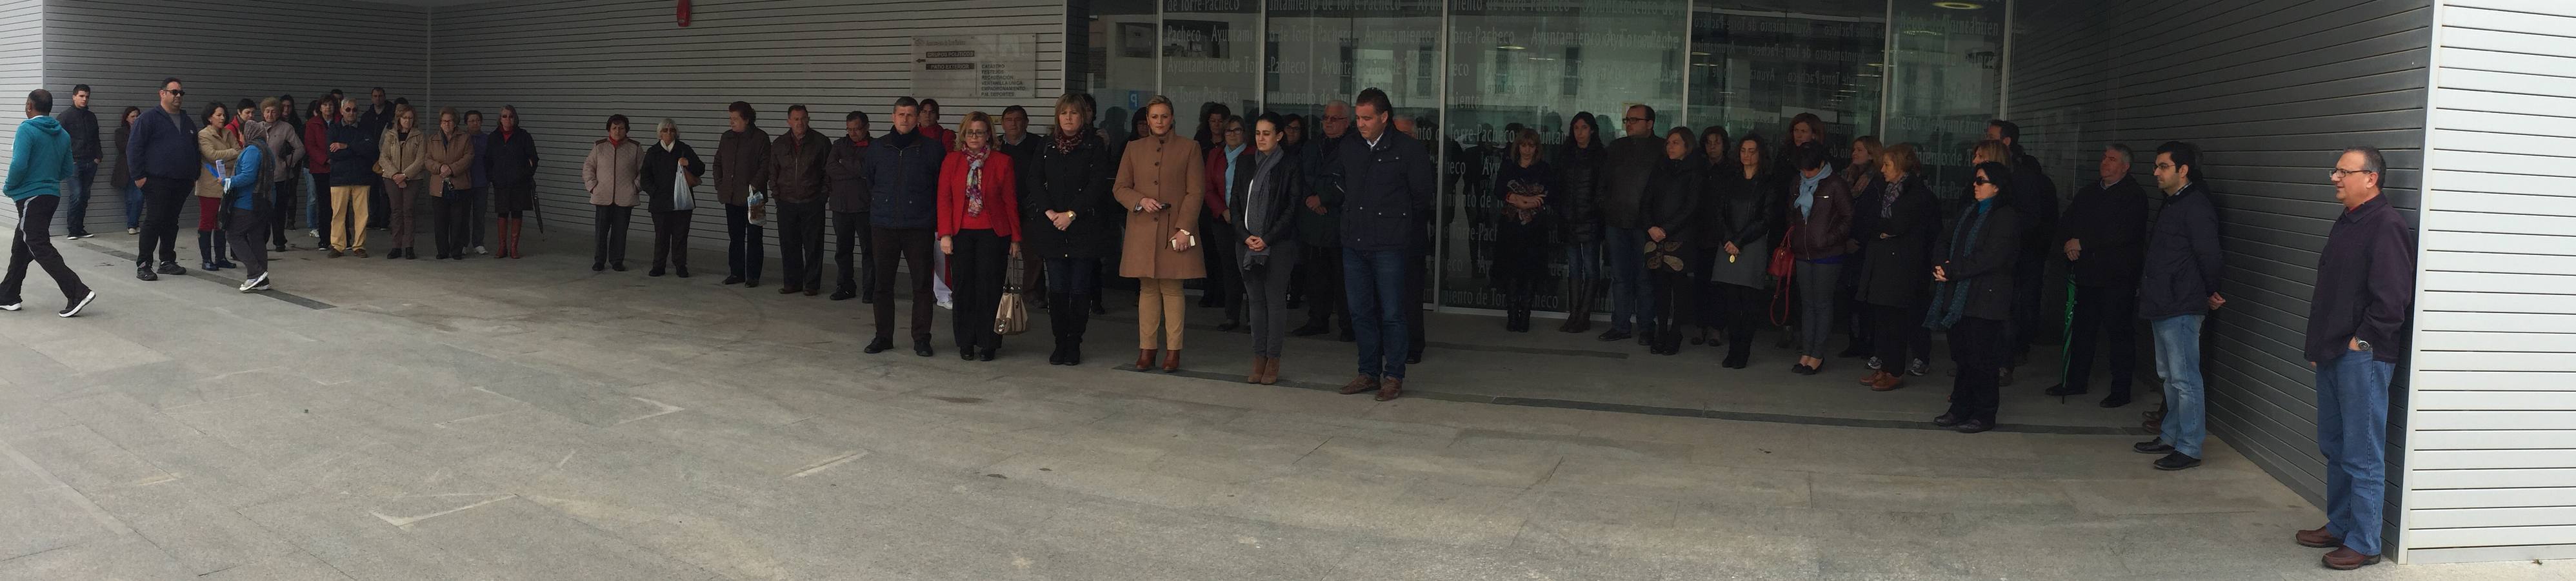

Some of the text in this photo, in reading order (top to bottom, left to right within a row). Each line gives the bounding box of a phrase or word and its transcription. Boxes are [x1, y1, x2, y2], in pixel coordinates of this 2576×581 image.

[1168, 25, 1201, 41] Pacheco
[1168, 56, 1226, 77] Ayuntamiento
[1229, 56, 1239, 72] de
[1480, 190, 1492, 208] de
[1476, 287, 1488, 305] de
